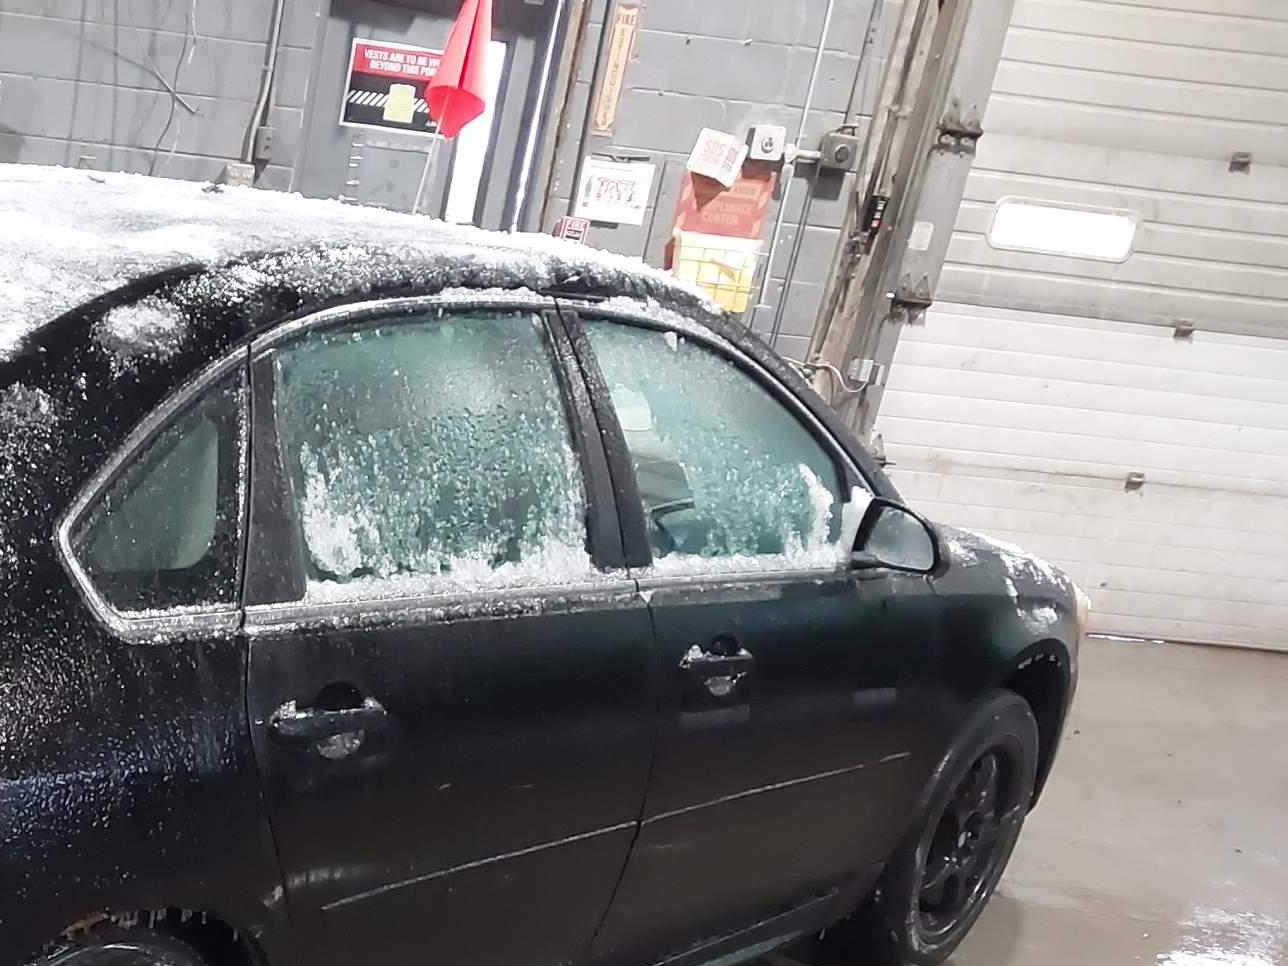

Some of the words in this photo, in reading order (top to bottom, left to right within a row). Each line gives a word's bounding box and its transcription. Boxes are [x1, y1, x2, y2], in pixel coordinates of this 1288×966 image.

[364, 48, 389, 60] VESTS
[389, 52, 405, 62] ARE
[406, 54, 416, 65] TO
[417, 56, 428, 66] BE
[370, 60, 402, 73] BEYOND
[402, 64, 420, 75] THIS
[566, 219, 587, 230] FIRE
